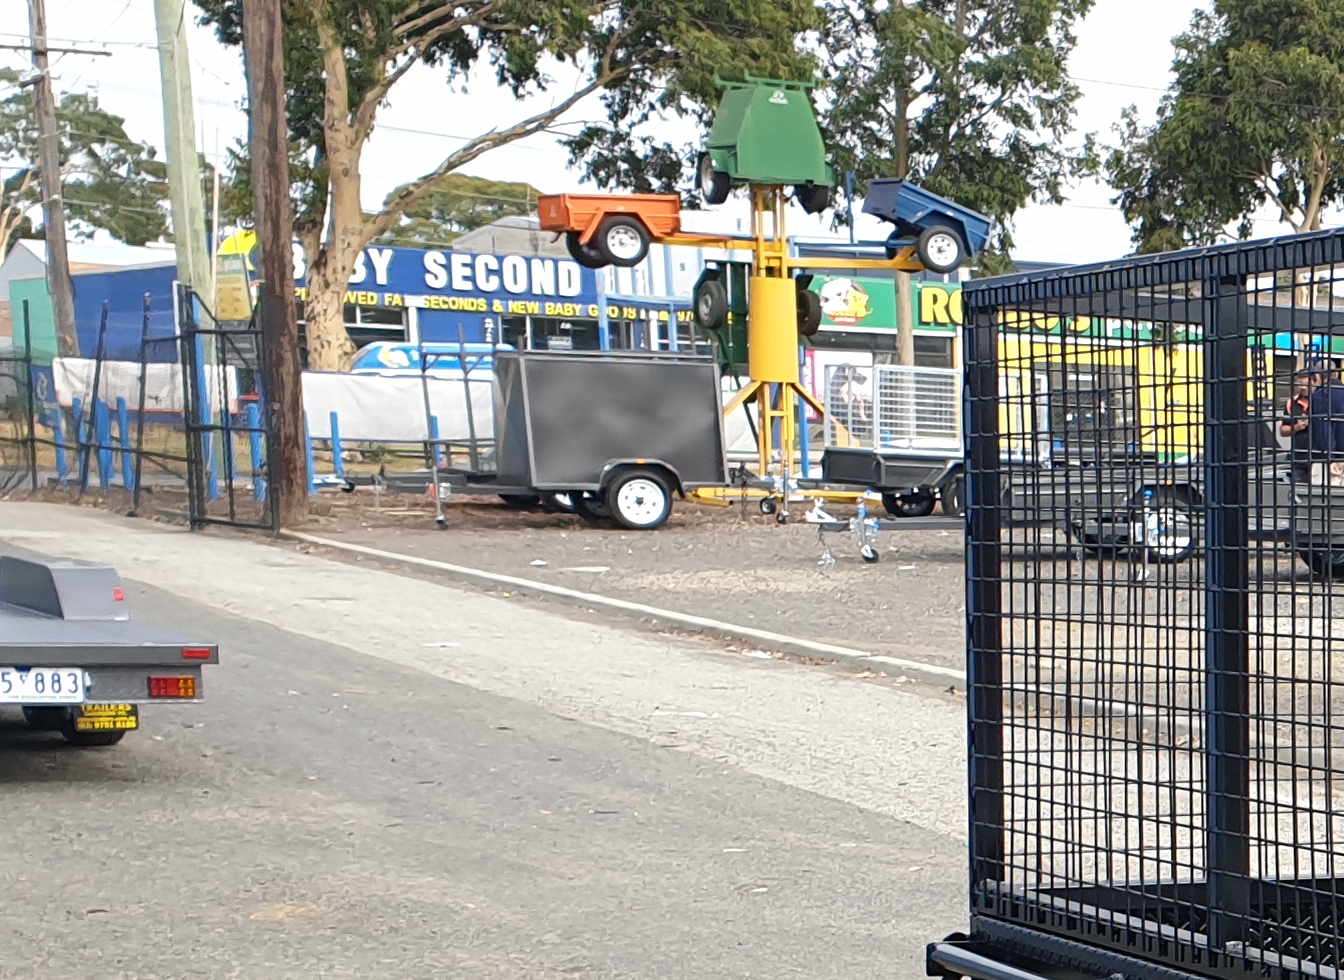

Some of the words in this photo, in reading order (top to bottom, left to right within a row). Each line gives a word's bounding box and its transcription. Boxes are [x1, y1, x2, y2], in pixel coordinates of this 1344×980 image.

[423, 250, 582, 297] SECOND
[493, 298, 504, 313] &
[508, 300, 540, 315] NEW
[545, 302, 582, 317] BABY
[35, 672, 79, 694] 883
